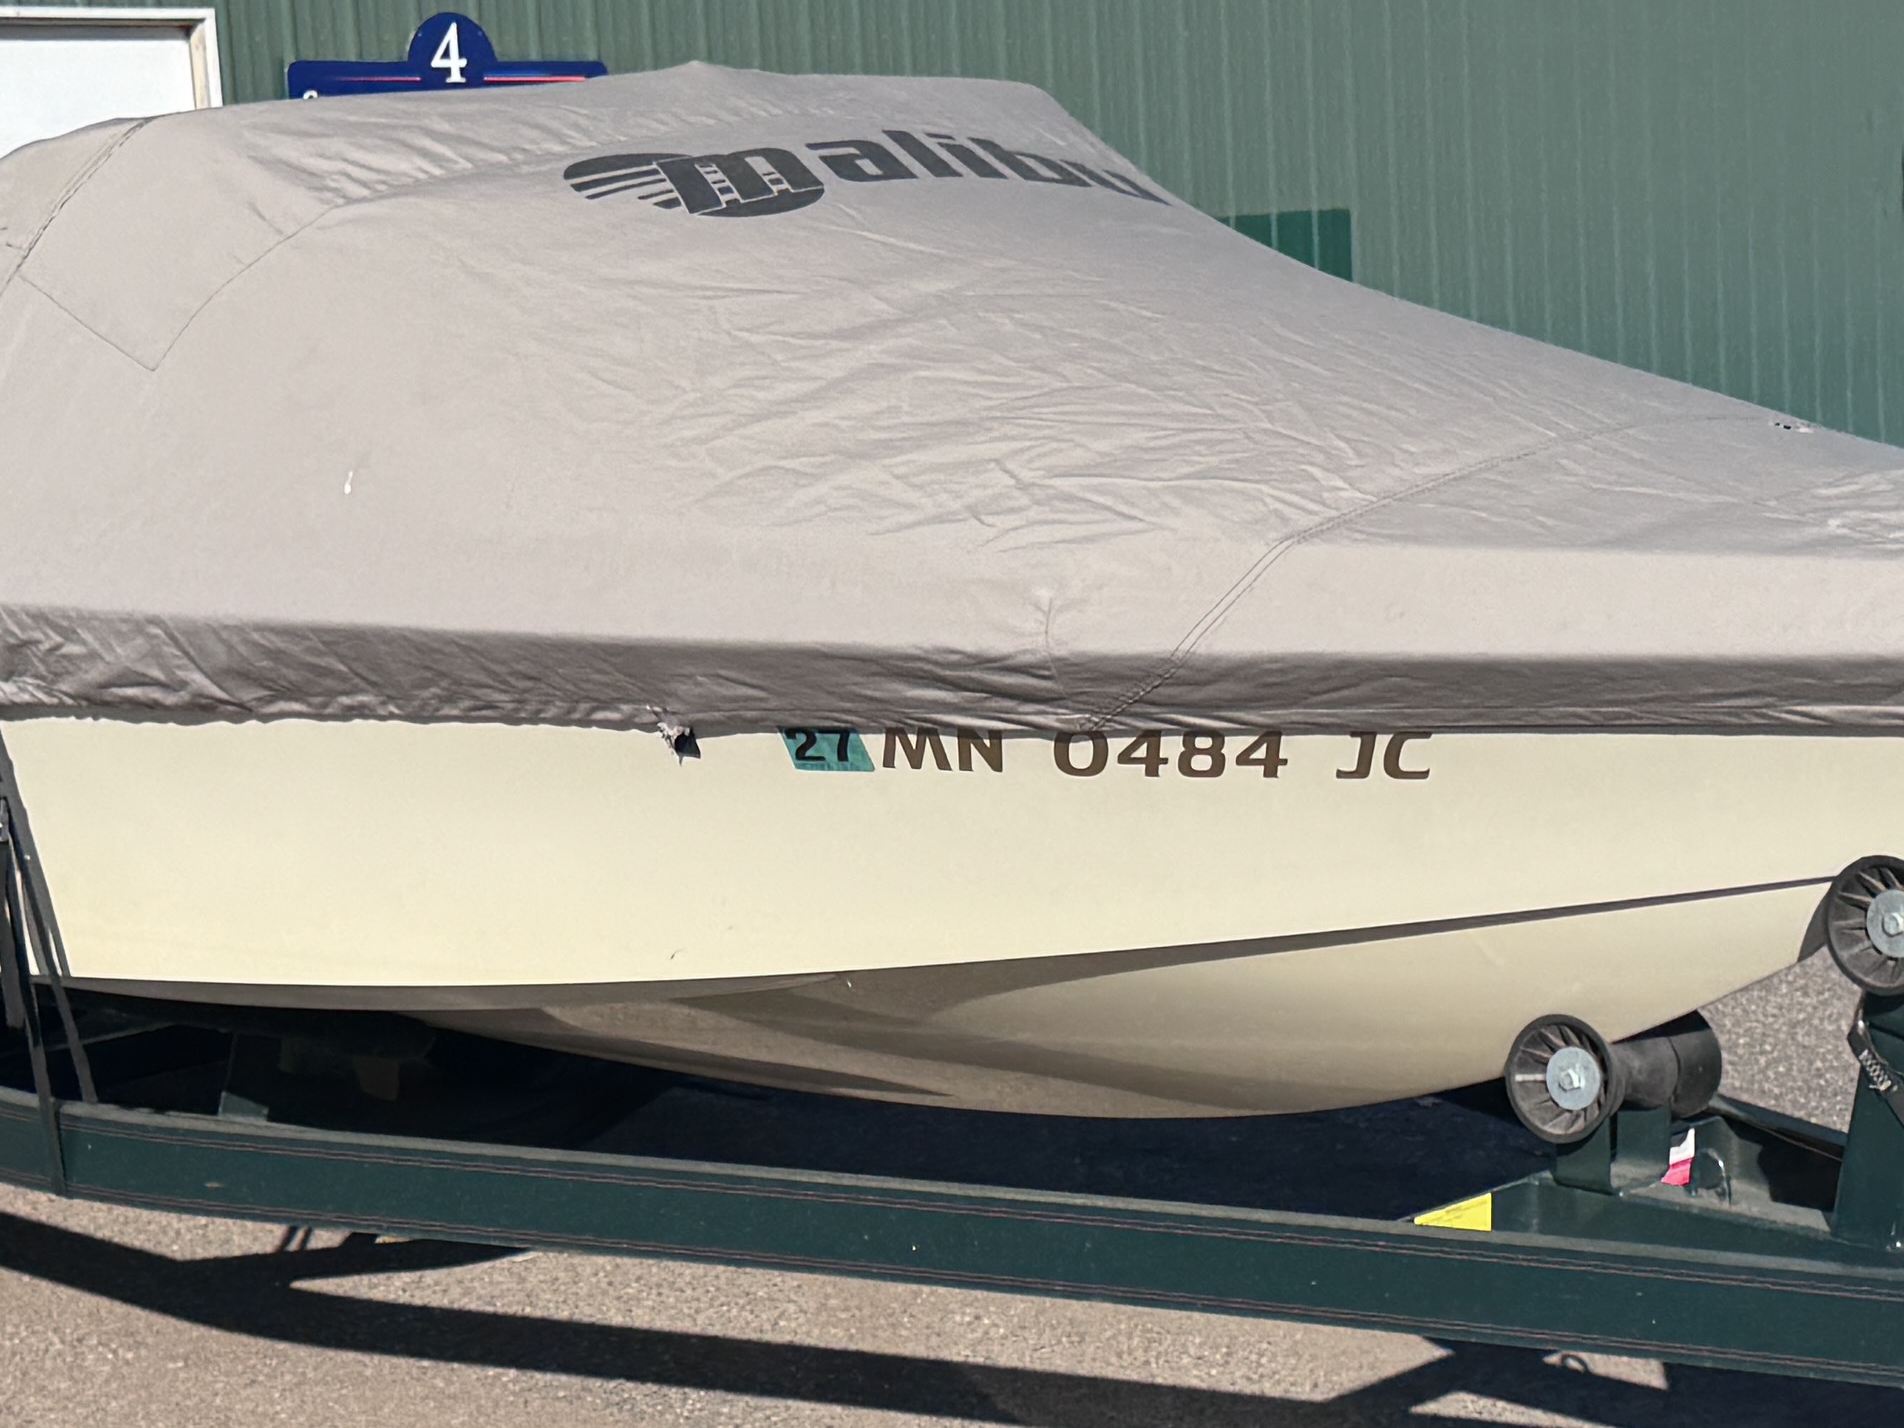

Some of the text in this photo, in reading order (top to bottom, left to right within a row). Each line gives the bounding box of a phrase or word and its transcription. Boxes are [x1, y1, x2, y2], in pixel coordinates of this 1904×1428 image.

[430, 22, 467, 83] 4
[785, 729, 851, 762] 27
[883, 727, 1432, 780] MN 0484 JC
